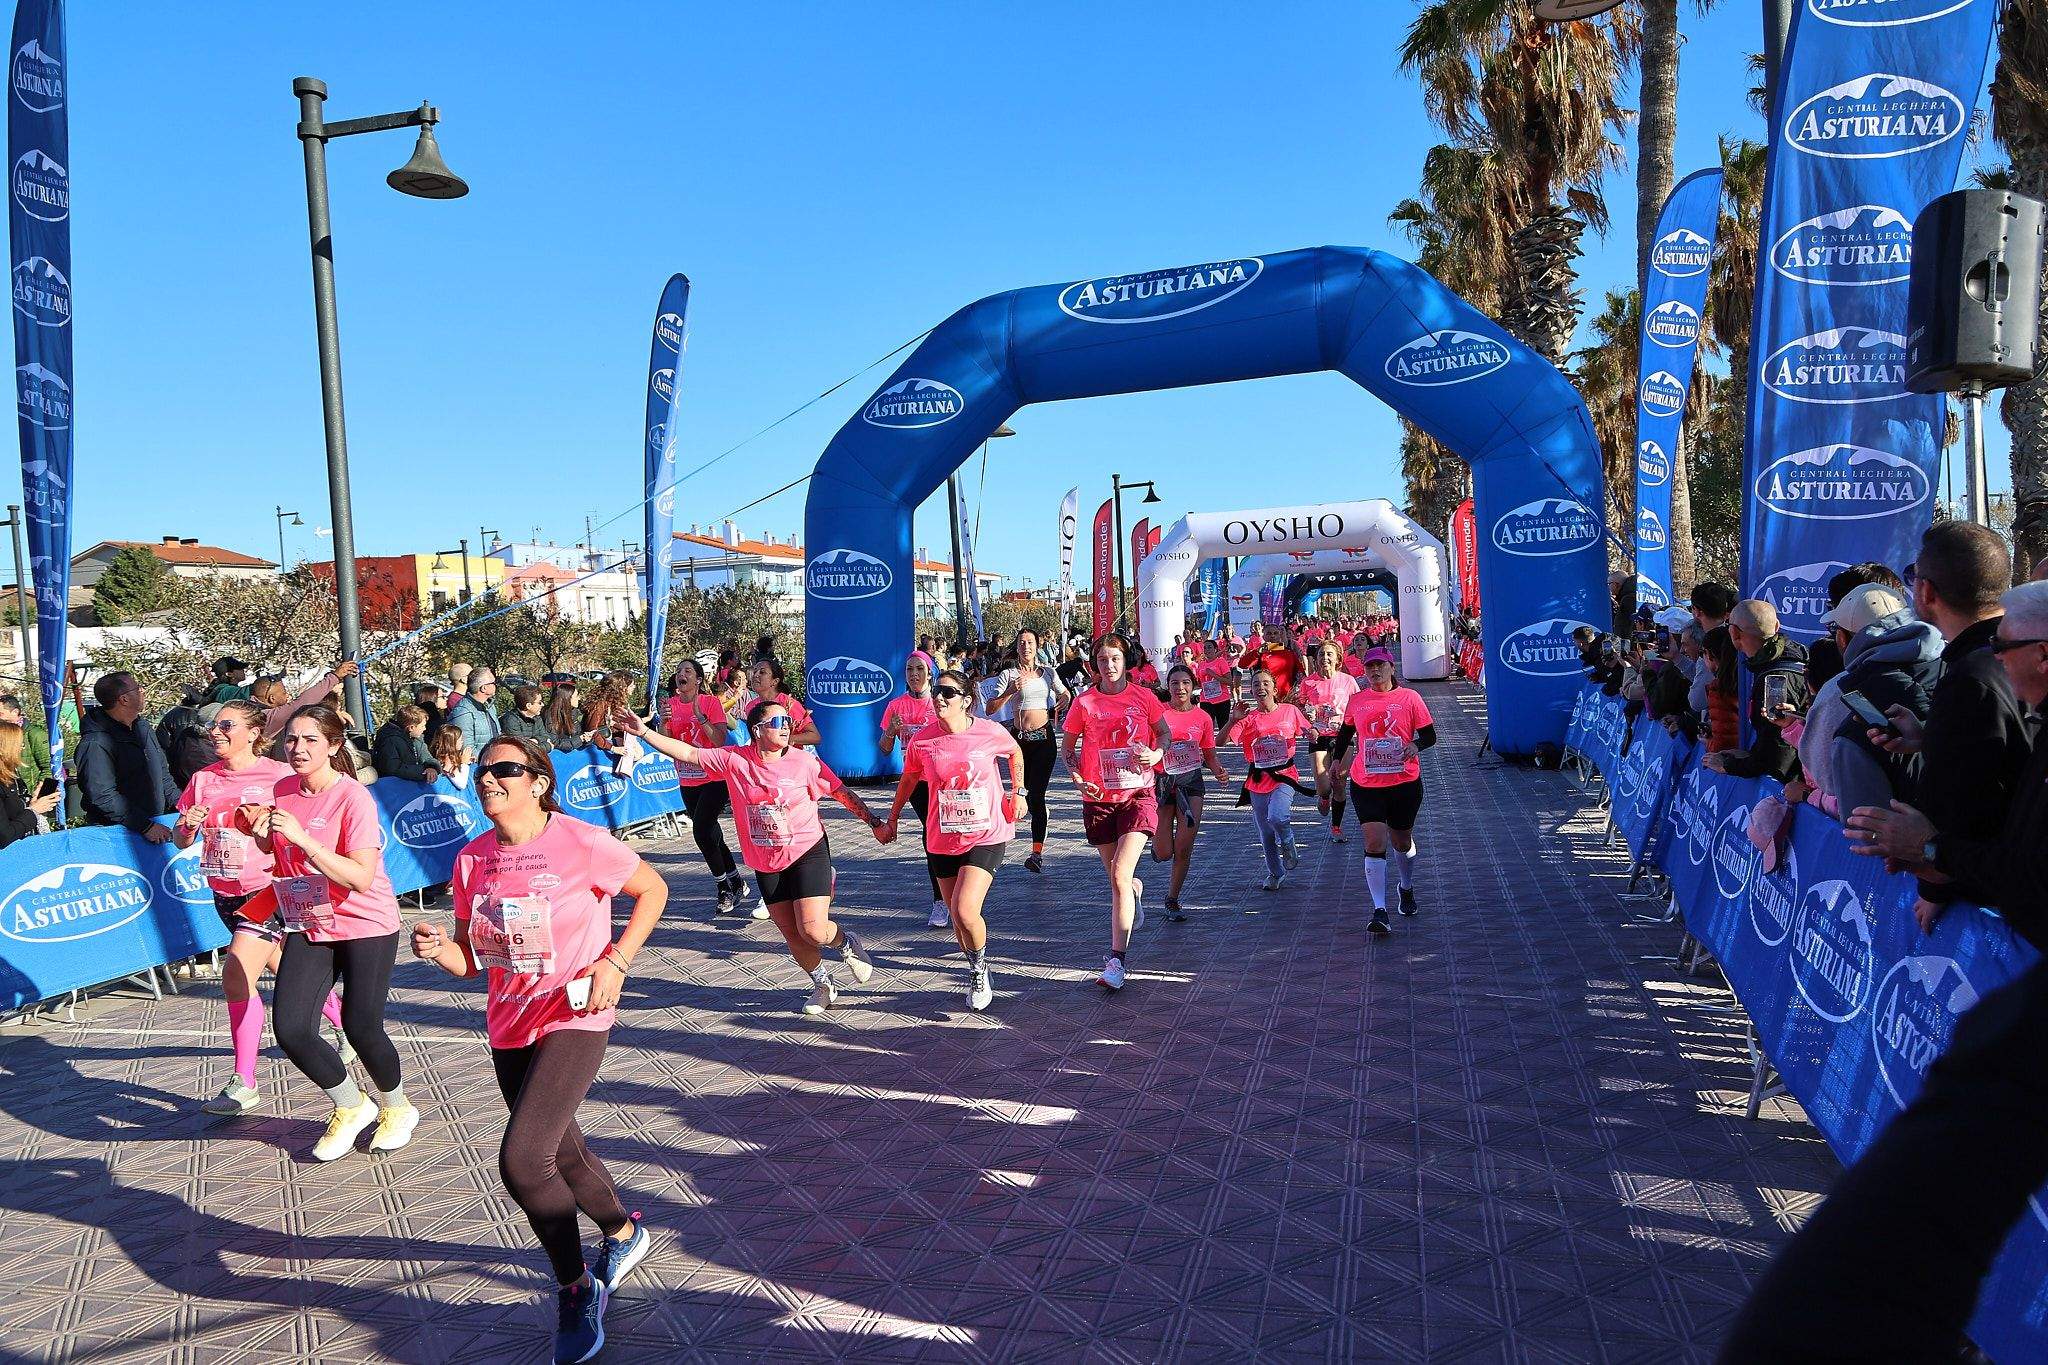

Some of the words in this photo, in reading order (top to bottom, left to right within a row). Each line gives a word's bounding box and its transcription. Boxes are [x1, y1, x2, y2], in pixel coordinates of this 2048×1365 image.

[1827, 103, 1877, 115] CENTRAL
[1883, 101, 1947, 111] LECHERA
[1795, 109, 1947, 142] ASTURIANA
[17, 170, 69, 208] ASTURIANA
[1811, 232, 1871, 243] CENTRAL
[1106, 271, 1170, 285] CENTRAL
[1176, 259, 1242, 275] LECHERA
[1072, 265, 1248, 310] ASTURIANA
[1649, 316, 1695, 338] ASTURIANA
[1456, 343, 1496, 352] LECHERA
[1395, 350, 1503, 378] ASTURIANA
[1799, 353, 1856, 362] CENTRAL
[1862, 353, 1906, 361] LECHE
[1773, 357, 1905, 386] ASTURIAN
[917, 391, 952, 399] LECHERA
[868, 400, 956, 419] ASTURIANA
[1790, 470, 1848, 479] CENTRAL
[1851, 470, 1912, 479] LECHERA
[1767, 472, 1916, 501] ASTURIANA
[1223, 513, 1344, 545] OYSHO
[1515, 517, 1556, 527] CENTRAL
[1380, 534, 1419, 545] OYSHO
[1500, 523, 1597, 545] ASTURIANA
[1100, 520, 1108, 585] Santander
[1463, 517, 1474, 572] Santander
[1155, 552, 1190, 561] OYSHO
[809, 569, 886, 589] ASTURIANA
[1315, 573, 1375, 581] VOLVO
[1142, 600, 1174, 609] OYSHO
[1407, 634, 1442, 643] OYSHO
[1522, 638, 1563, 646] CENTRAL
[810, 676, 887, 695] ASTURIANA
[956, 808, 975, 817] 016
[761, 823, 778, 831] 016
[213, 849, 230, 859] 016
[499, 866, 514, 875] por
[515, 863, 522, 872] la
[525, 863, 548, 871] causa
[32, 889, 84, 905] CENTRAL
[88, 876, 137, 894] LECHERA
[13, 885, 147, 934] ASTURIANA
[295, 901, 314, 911] 016
[1795, 905, 1862, 1008] ASTURIANA
